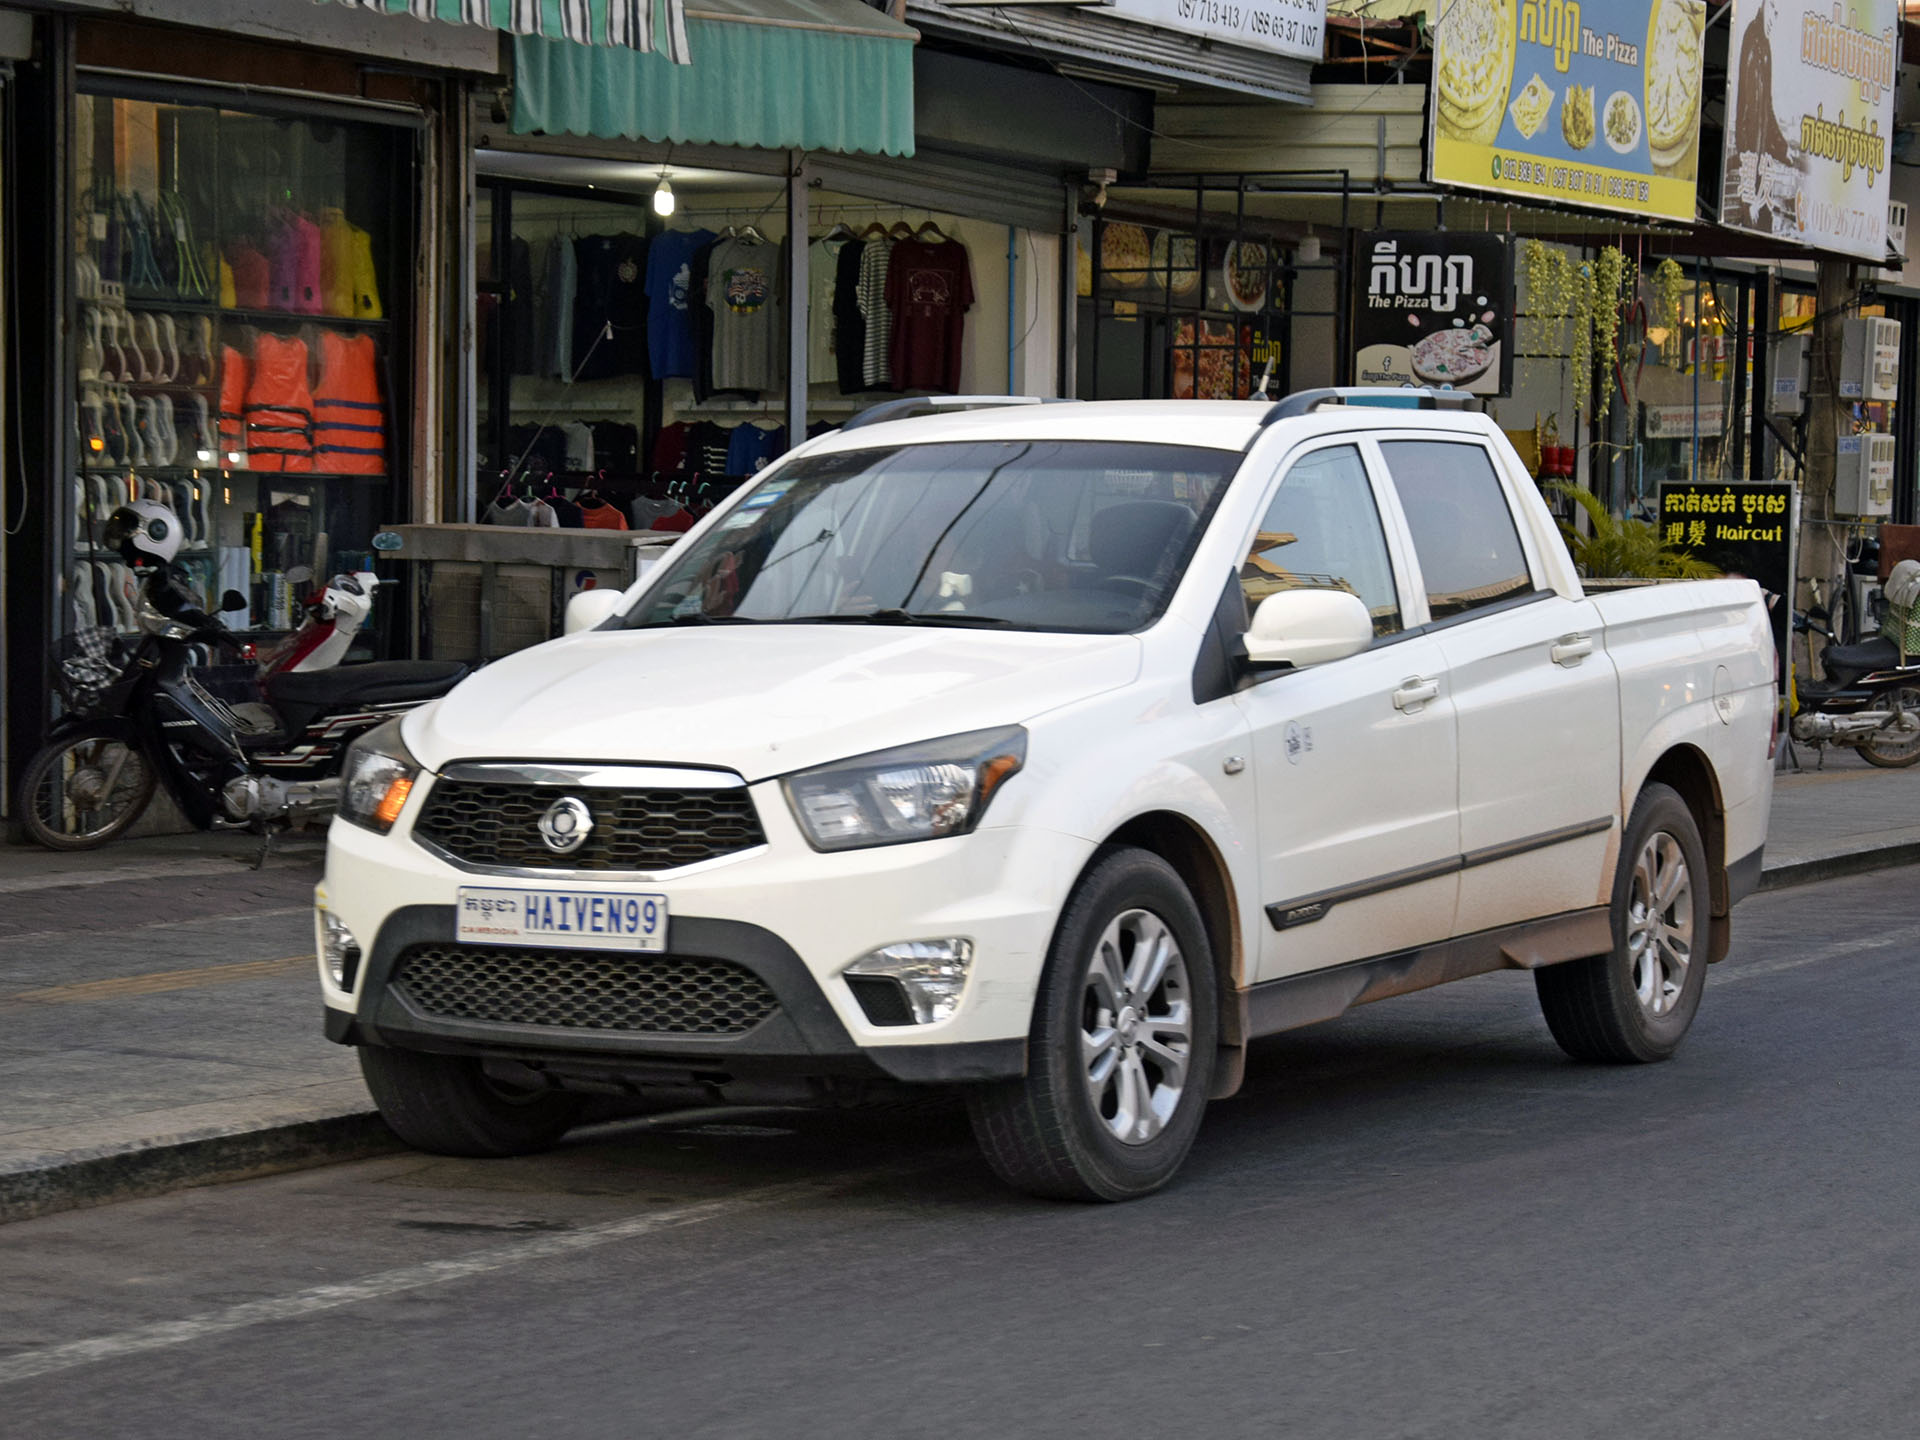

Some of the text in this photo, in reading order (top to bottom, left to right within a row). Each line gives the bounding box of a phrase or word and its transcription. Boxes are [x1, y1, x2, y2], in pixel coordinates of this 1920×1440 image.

[1199, 0, 1218, 24] 713
[1221, 4, 1240, 29] 413
[1251, 10, 1270, 35] 088
[1271, 16, 1284, 38] 65
[1286, 19, 1299, 42] 37
[1301, 24, 1318, 47] 107
[1582, 26, 1639, 66] The Pizza
[1503, 158, 1516, 180] 012
[1851, 209, 1865, 240] 77
[1368, 295, 1429, 308] The Pizza
[1665, 486, 1786, 524] កាត់សក់ បុរស
[1716, 525, 1783, 542] Haircut
[525, 894, 657, 934] HAIVEN99
[461, 926, 519, 936] CAMBODIA
